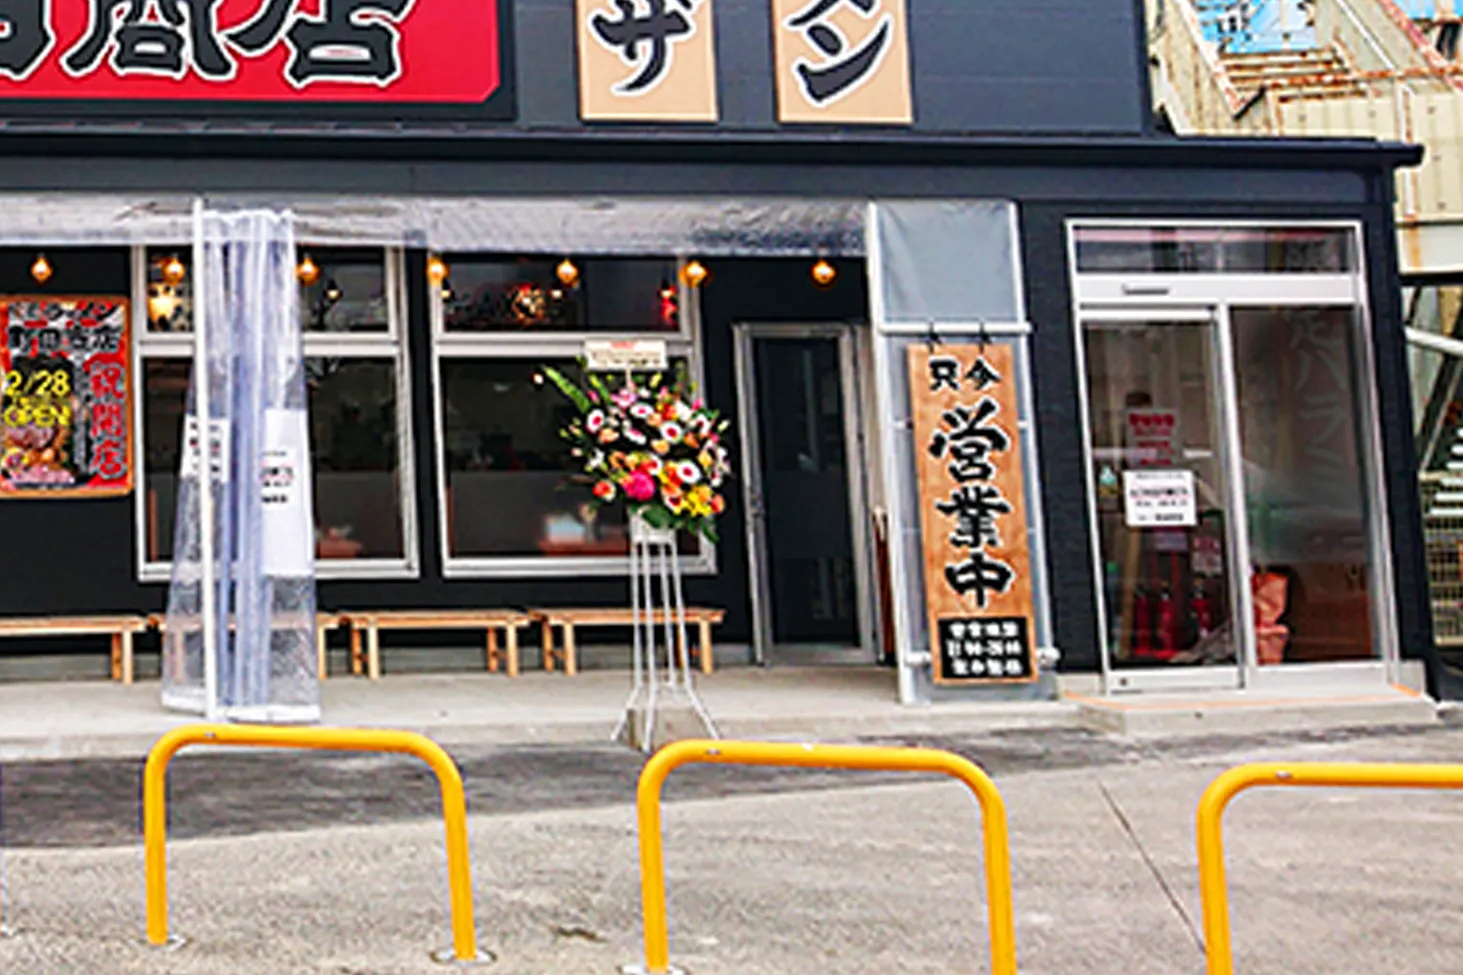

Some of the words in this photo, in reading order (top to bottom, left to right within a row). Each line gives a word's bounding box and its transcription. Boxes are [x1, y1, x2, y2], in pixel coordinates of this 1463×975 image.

[4, 369, 72, 398] 2/28
[927, 357, 1001, 392] 只今
[2, 403, 73, 429] OPEN
[927, 398, 1015, 609] 営業中
